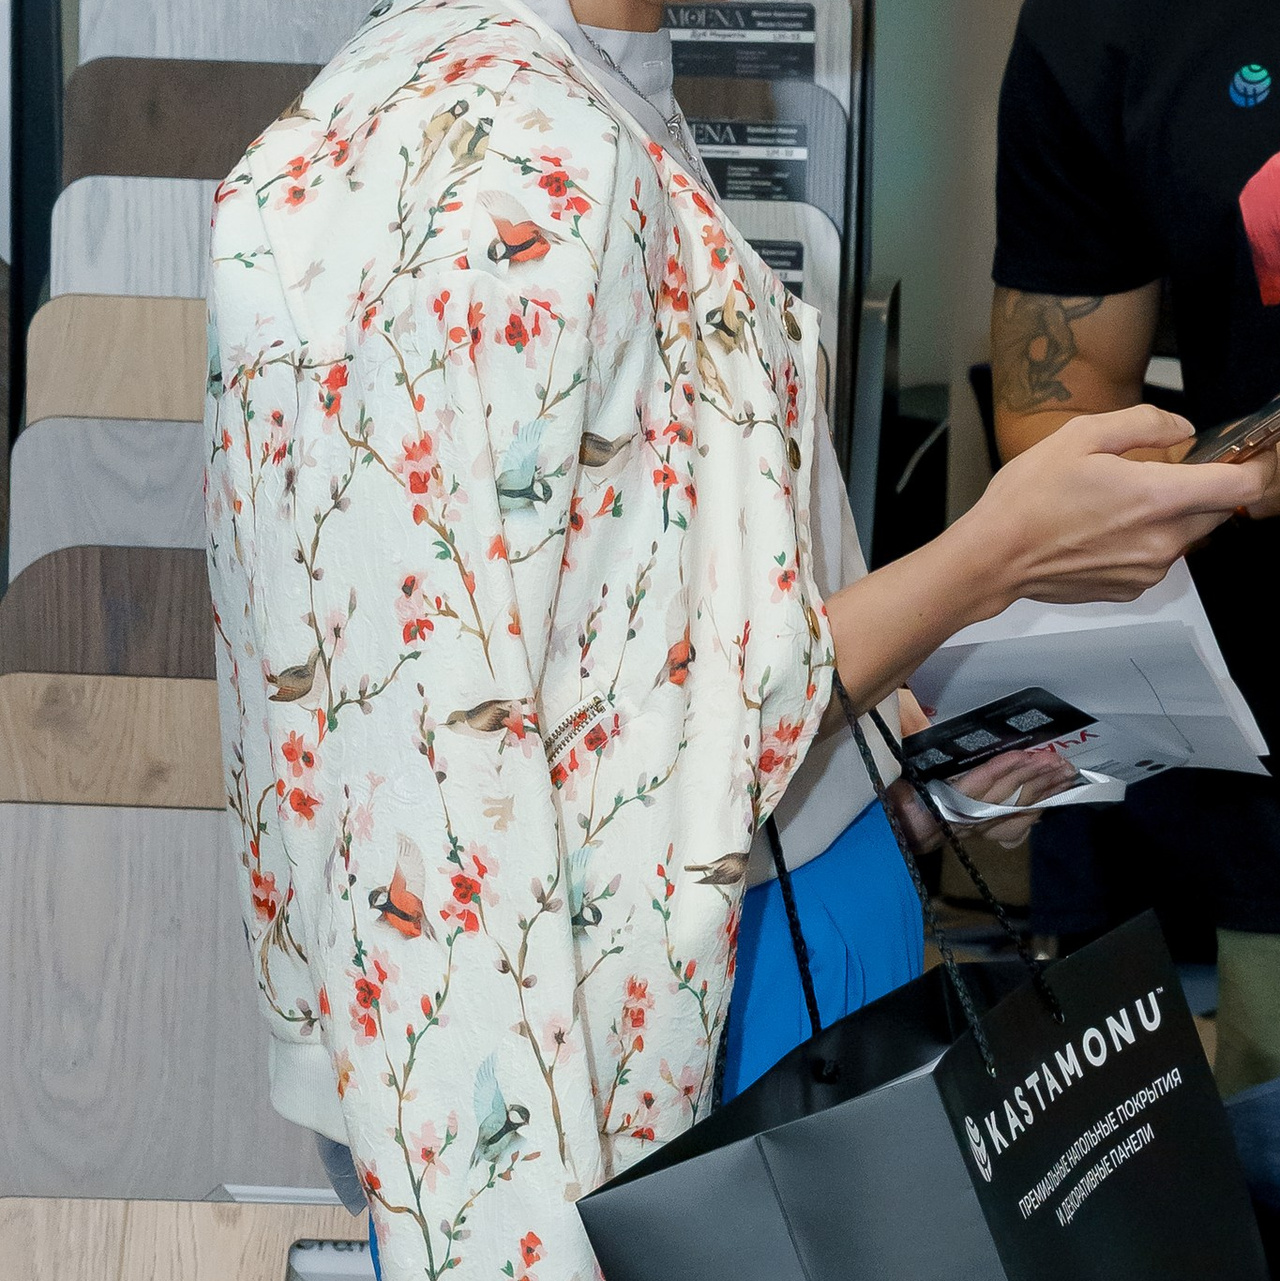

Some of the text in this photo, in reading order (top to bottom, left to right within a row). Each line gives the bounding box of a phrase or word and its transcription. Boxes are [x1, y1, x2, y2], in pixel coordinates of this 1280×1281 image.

[692, 124, 737, 143] ENA
[985, 991, 1161, 1155] KASTAMONU
[1018, 1068, 1182, 1219] ПРЕМИАЛЬНЫЕ НАПОЛЬНЫЕ ПОКРЫТИЯ
[1055, 1123, 1155, 1227] И ДЕКОРАТИВНЫЕ ПАНЕЛИ
